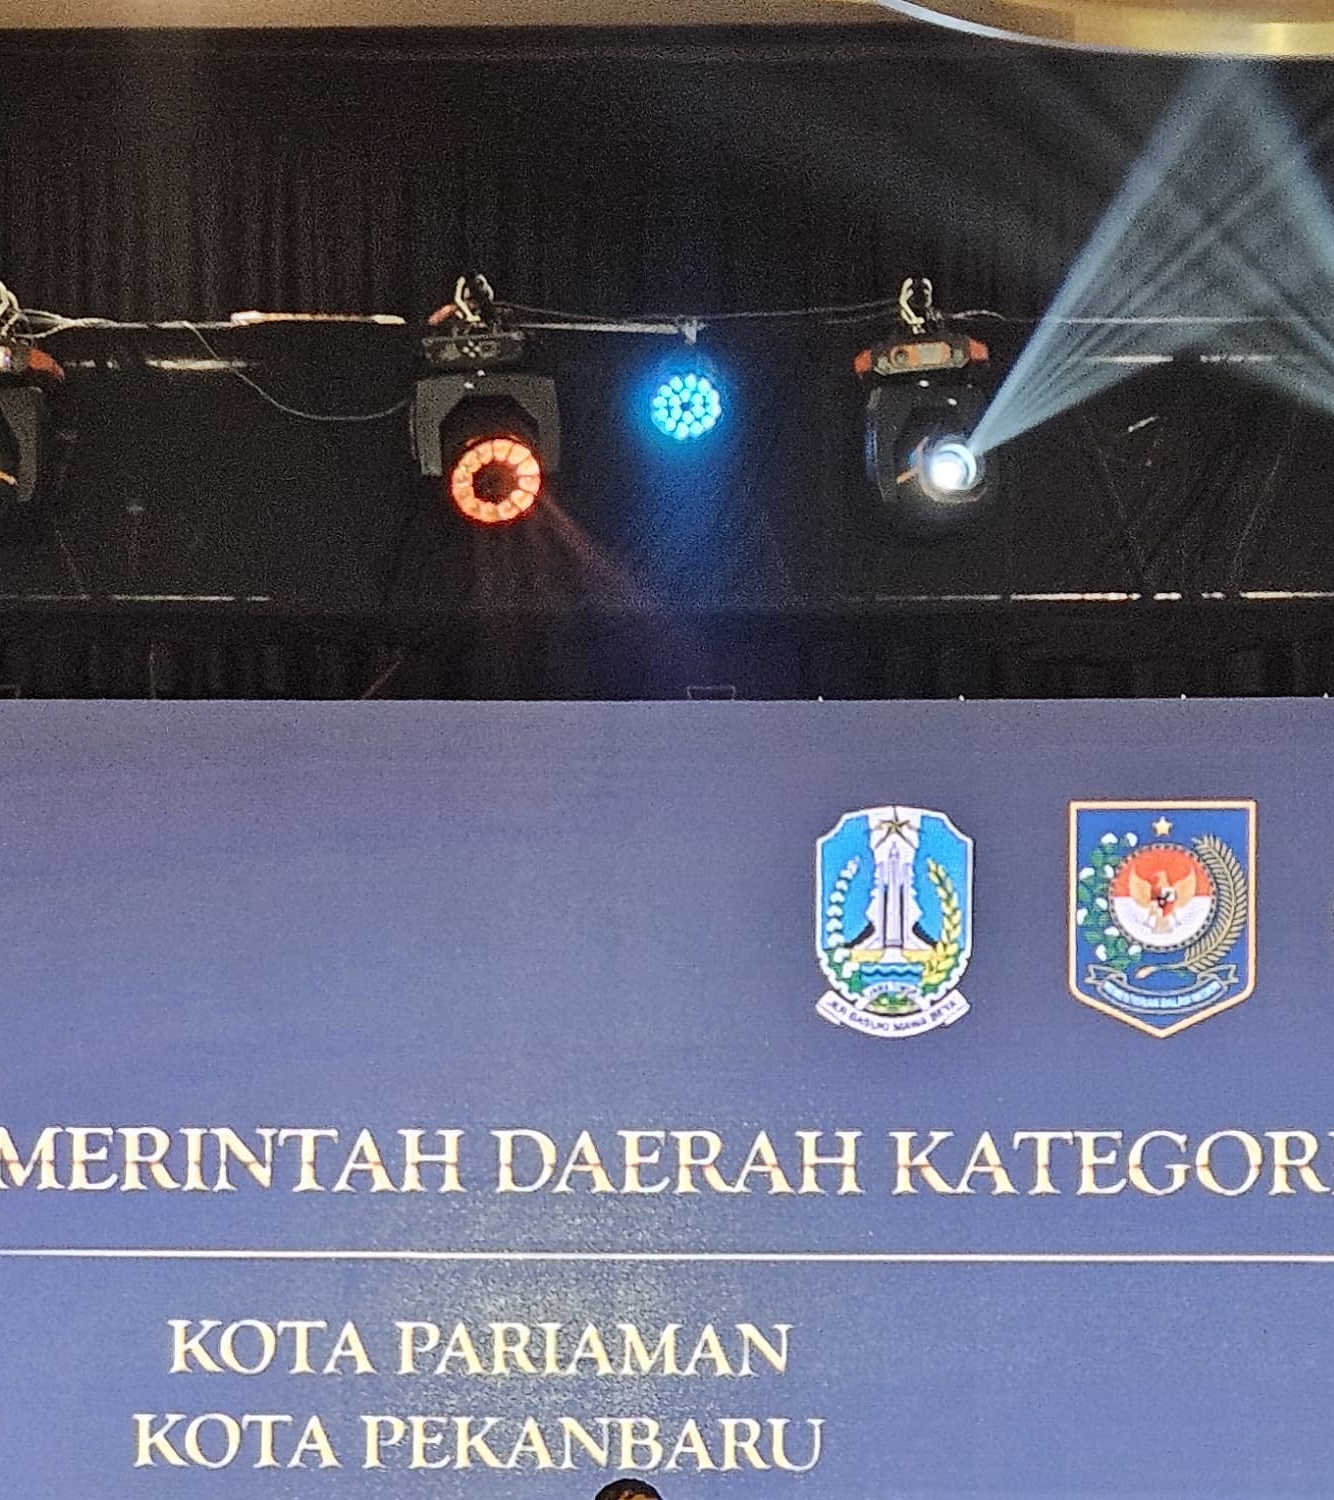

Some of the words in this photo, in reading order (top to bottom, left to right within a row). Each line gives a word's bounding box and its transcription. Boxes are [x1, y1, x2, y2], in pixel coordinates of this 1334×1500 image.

[491, 1129, 862, 1196] DAERAH
[167, 1319, 375, 1375] KOTA
[394, 1321, 791, 1378] PARIAMAN
[132, 1413, 340, 1469] KOTA
[360, 1415, 824, 1472] PEKANBARU
